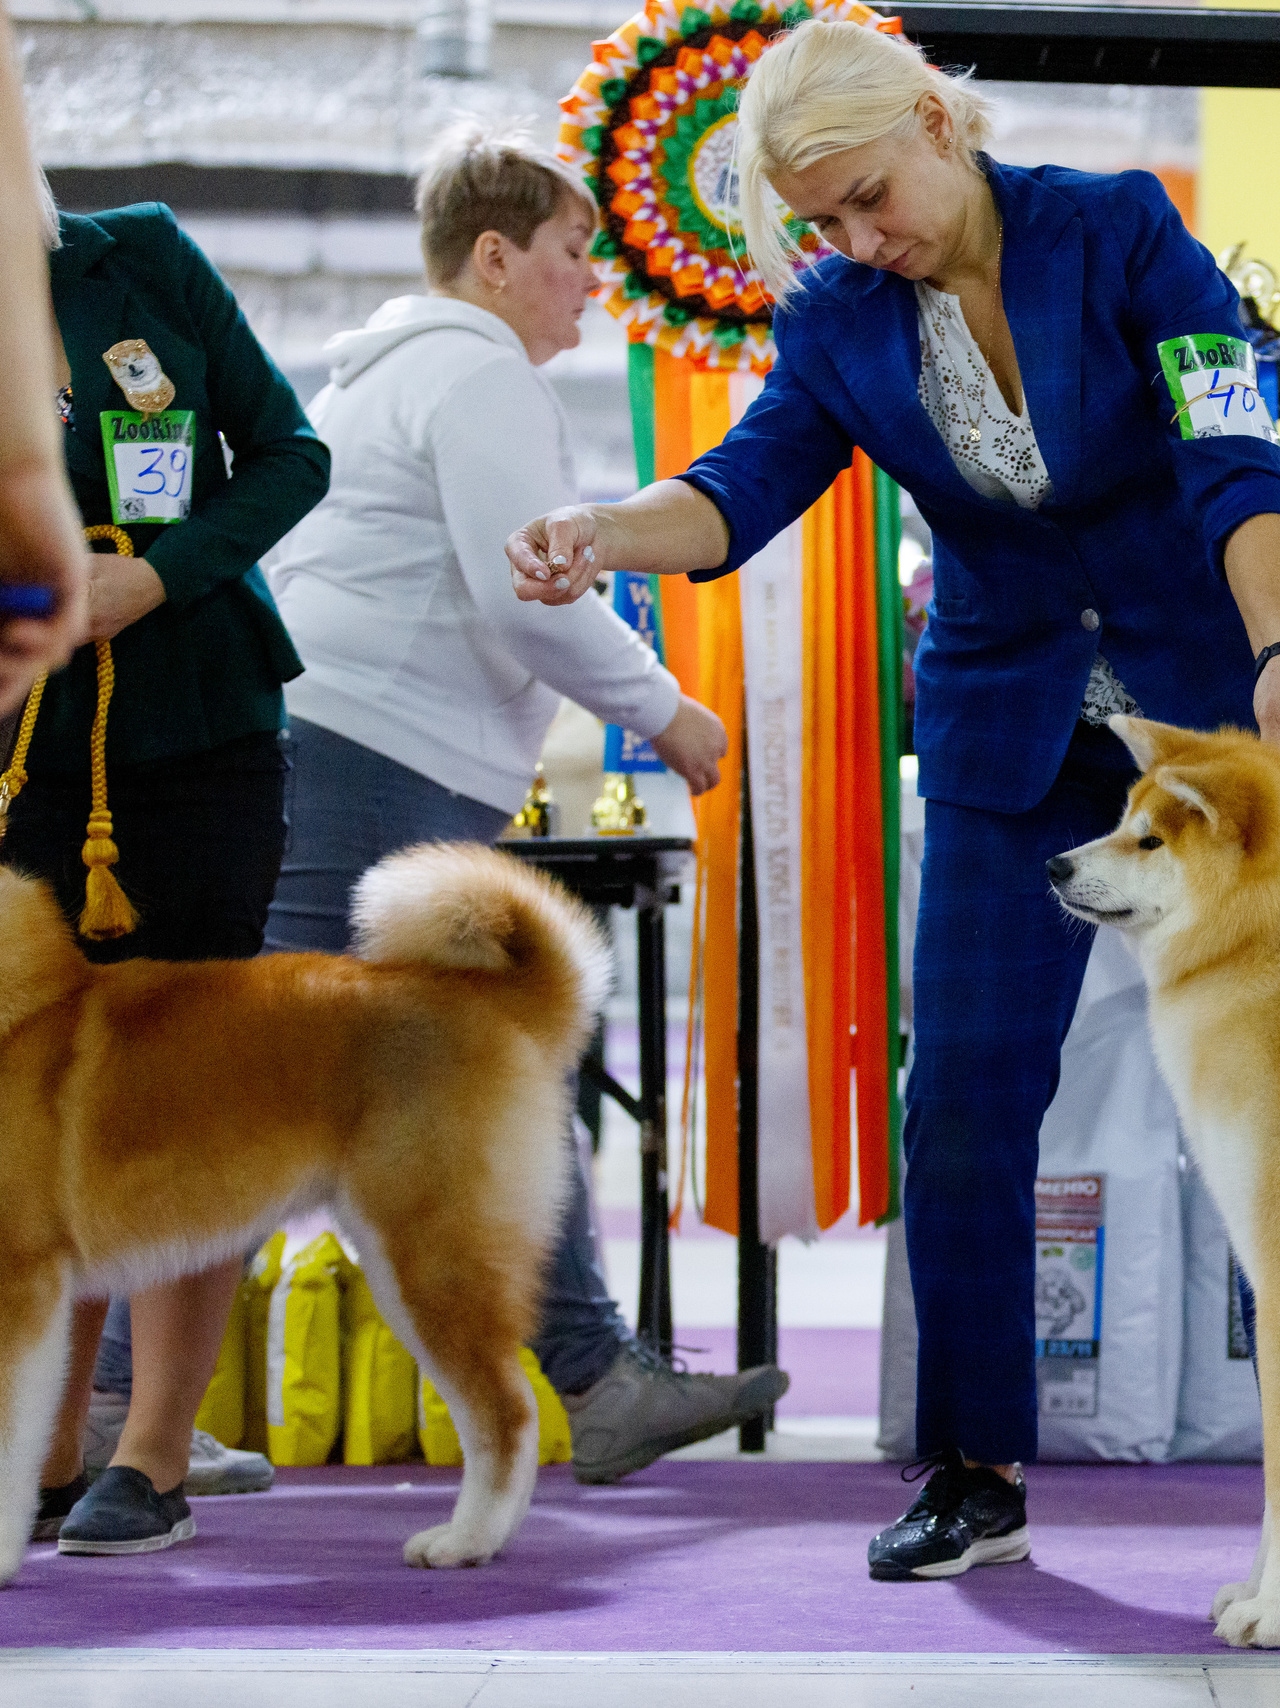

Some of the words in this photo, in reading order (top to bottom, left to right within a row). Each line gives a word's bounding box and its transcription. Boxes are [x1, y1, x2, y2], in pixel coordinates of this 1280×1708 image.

[1174, 342, 1256, 380] ZooRin
[1207, 369, 1256, 418] 40
[132, 447, 187, 498] 39
